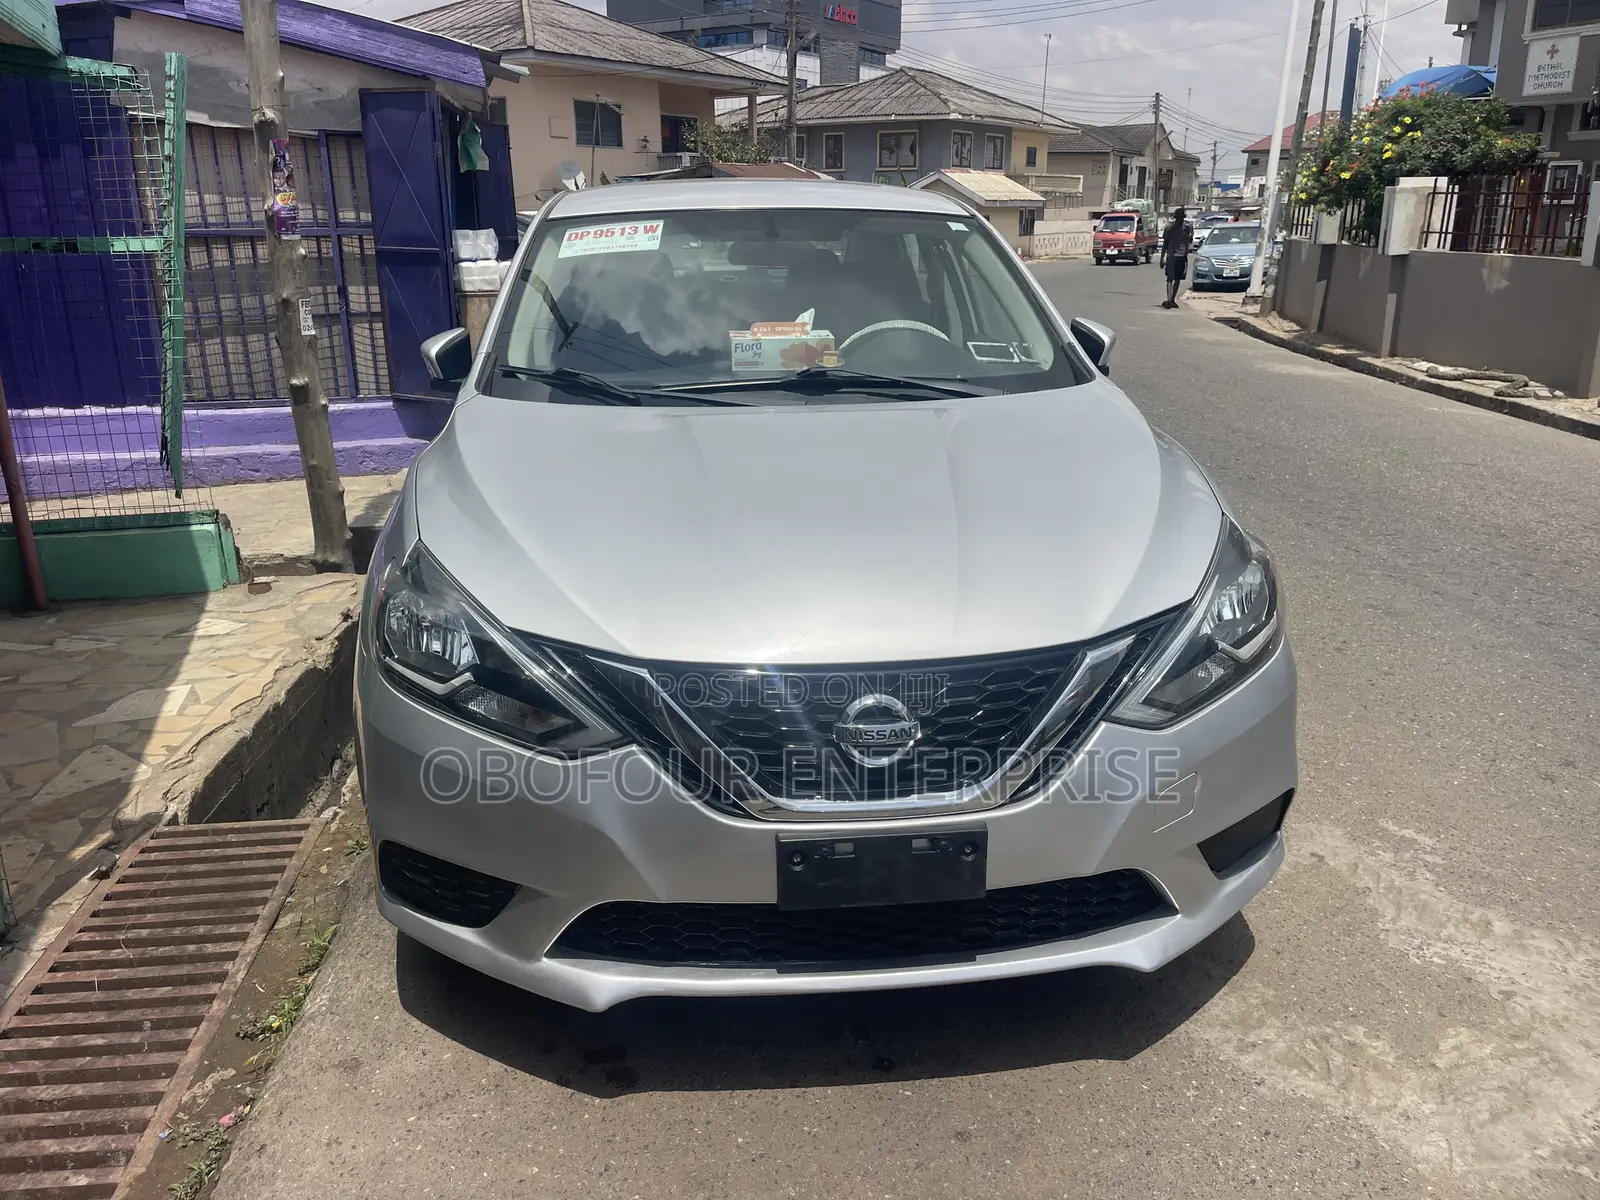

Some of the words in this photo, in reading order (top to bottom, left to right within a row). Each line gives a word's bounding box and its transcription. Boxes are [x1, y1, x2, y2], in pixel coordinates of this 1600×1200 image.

[1537, 63, 1563, 72] BETHEL
[1528, 71, 1571, 81] METHODIST
[1532, 81, 1563, 90] CHURCH
[643, 224, 660, 235] W
[734, 342, 762, 353] Flora
[843, 726, 912, 743] NISSAN
